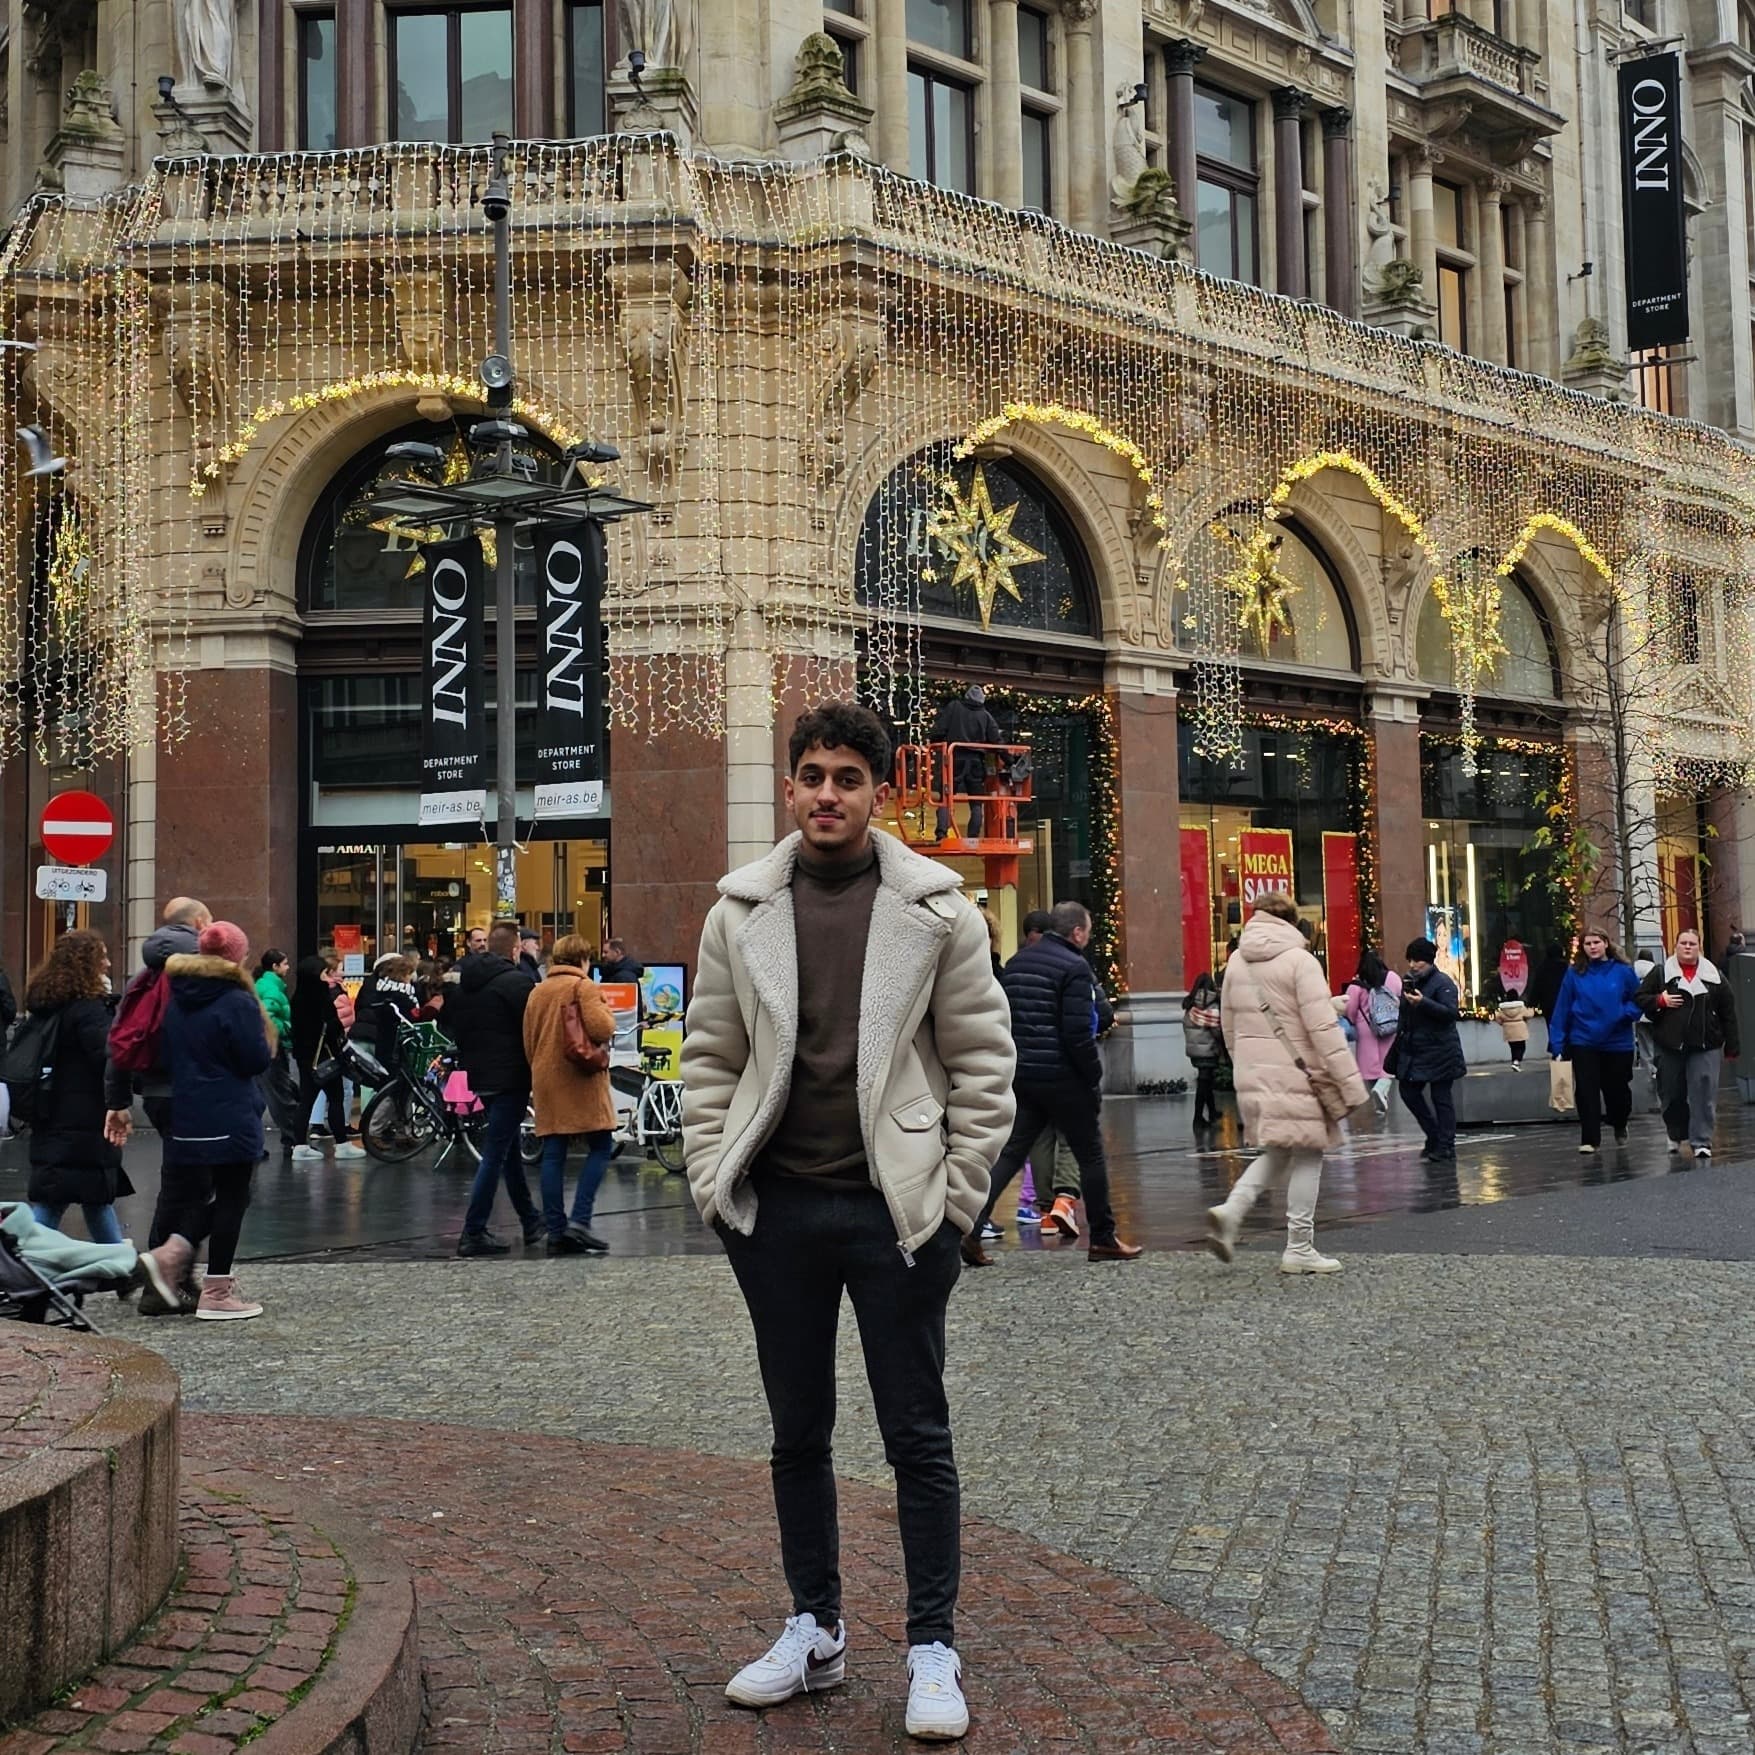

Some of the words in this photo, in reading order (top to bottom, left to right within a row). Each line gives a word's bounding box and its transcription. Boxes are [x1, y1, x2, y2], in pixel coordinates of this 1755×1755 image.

[1631, 79, 1669, 191] INNO
[1632, 292, 1681, 308] DEPARTMENT
[1645, 303, 1669, 313] STORE
[546, 540, 584, 719] INNO
[432, 558, 468, 730] INNO
[537, 744, 596, 758] DEPARTMENT
[423, 754, 479, 769] DEPARTMENT
[551, 759, 581, 771] STORE
[437, 769, 464, 780] STORE
[536, 791, 598, 807] meir-as.be
[422, 800, 481, 815] meir-as.be
[1244, 853, 1289, 875] MEGA
